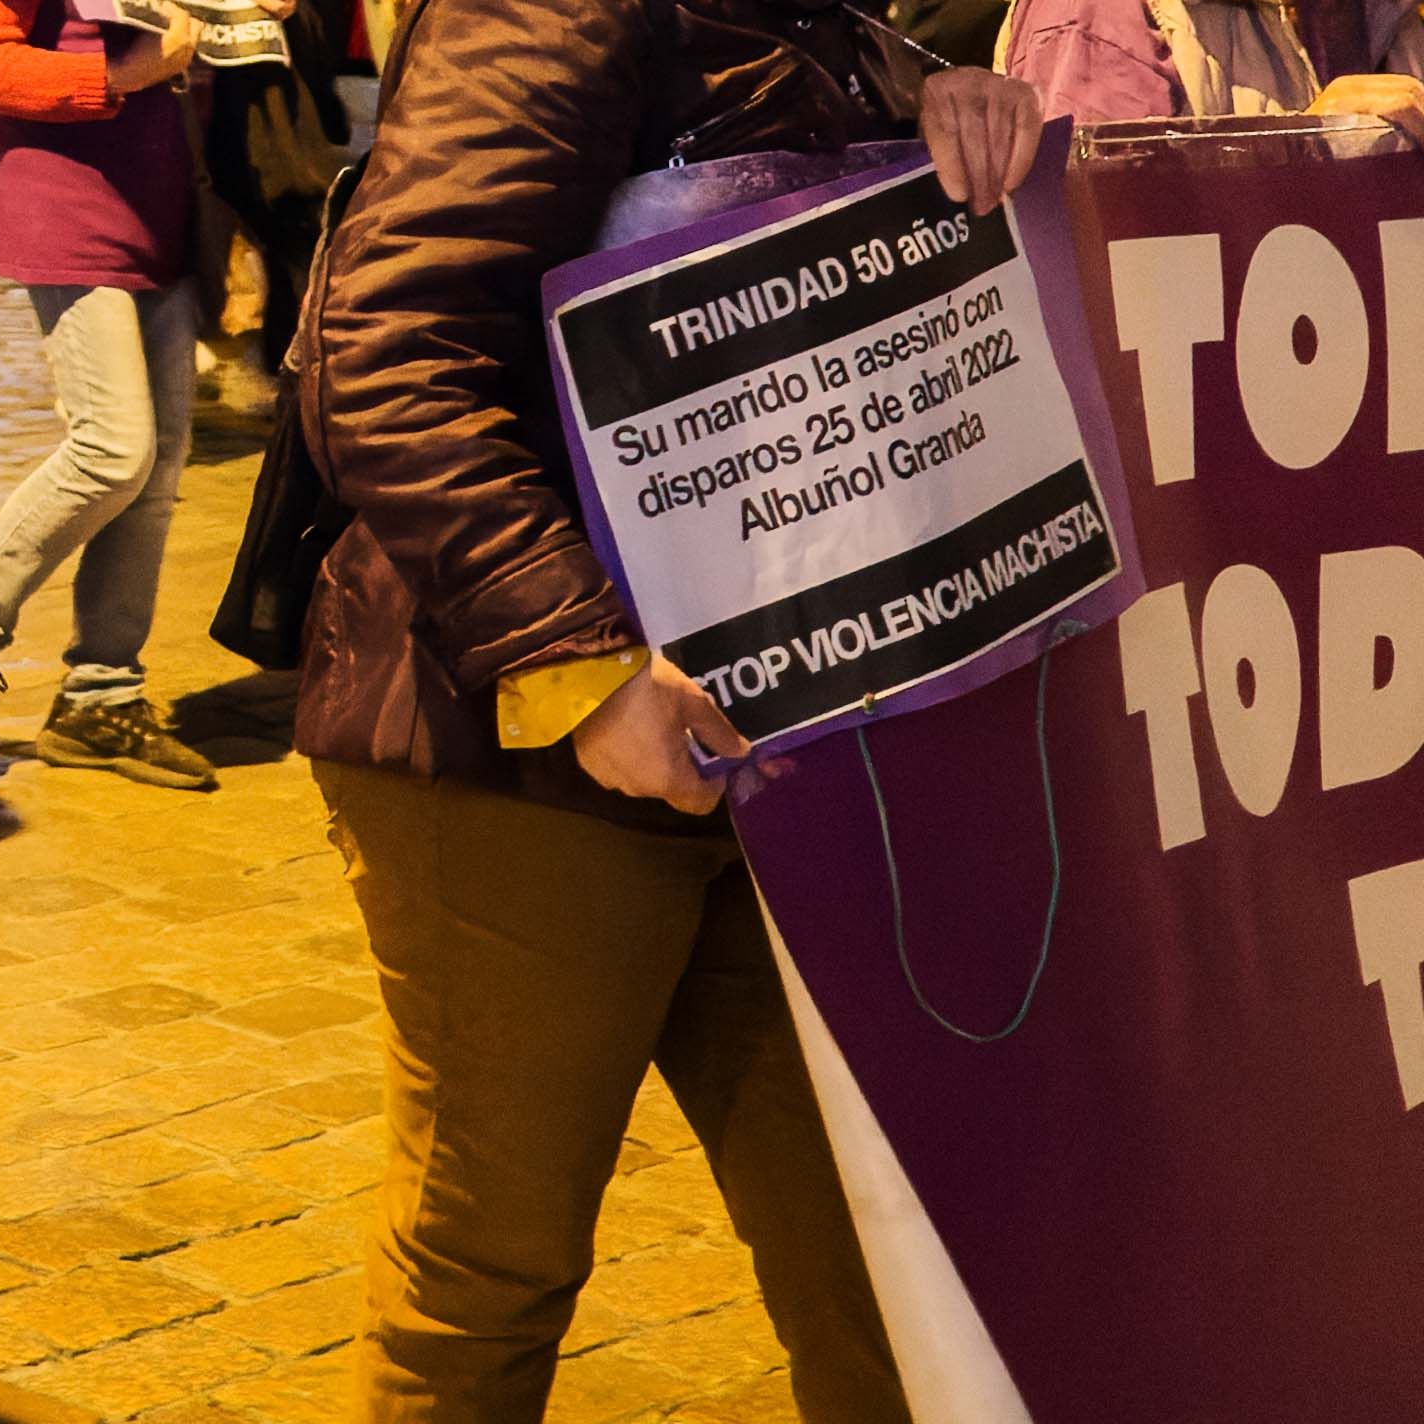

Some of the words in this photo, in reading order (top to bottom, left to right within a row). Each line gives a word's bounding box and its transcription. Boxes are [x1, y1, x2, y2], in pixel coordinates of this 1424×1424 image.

[611, 423, 669, 466] Su
[673, 370, 809, 446] marido
[811, 353, 851, 393] la
[853, 294, 959, 377] asesinó
[962, 285, 1004, 328] con
[649, 256, 849, 359] TRINIDAD
[850, 237, 895, 284] 50
[896, 211, 971, 266] años
[637, 434, 803, 518] disparos
[804, 403, 856, 456] 25
[860, 390, 905, 434] de
[907, 355, 964, 414] abril
[960, 328, 1021, 387] 2022
[739, 450, 885, 543] Albuñol
[692, 644, 791, 709] TOP
[790, 566, 988, 675] VIOLENCIA
[980, 500, 1105, 597] MACHISTA
